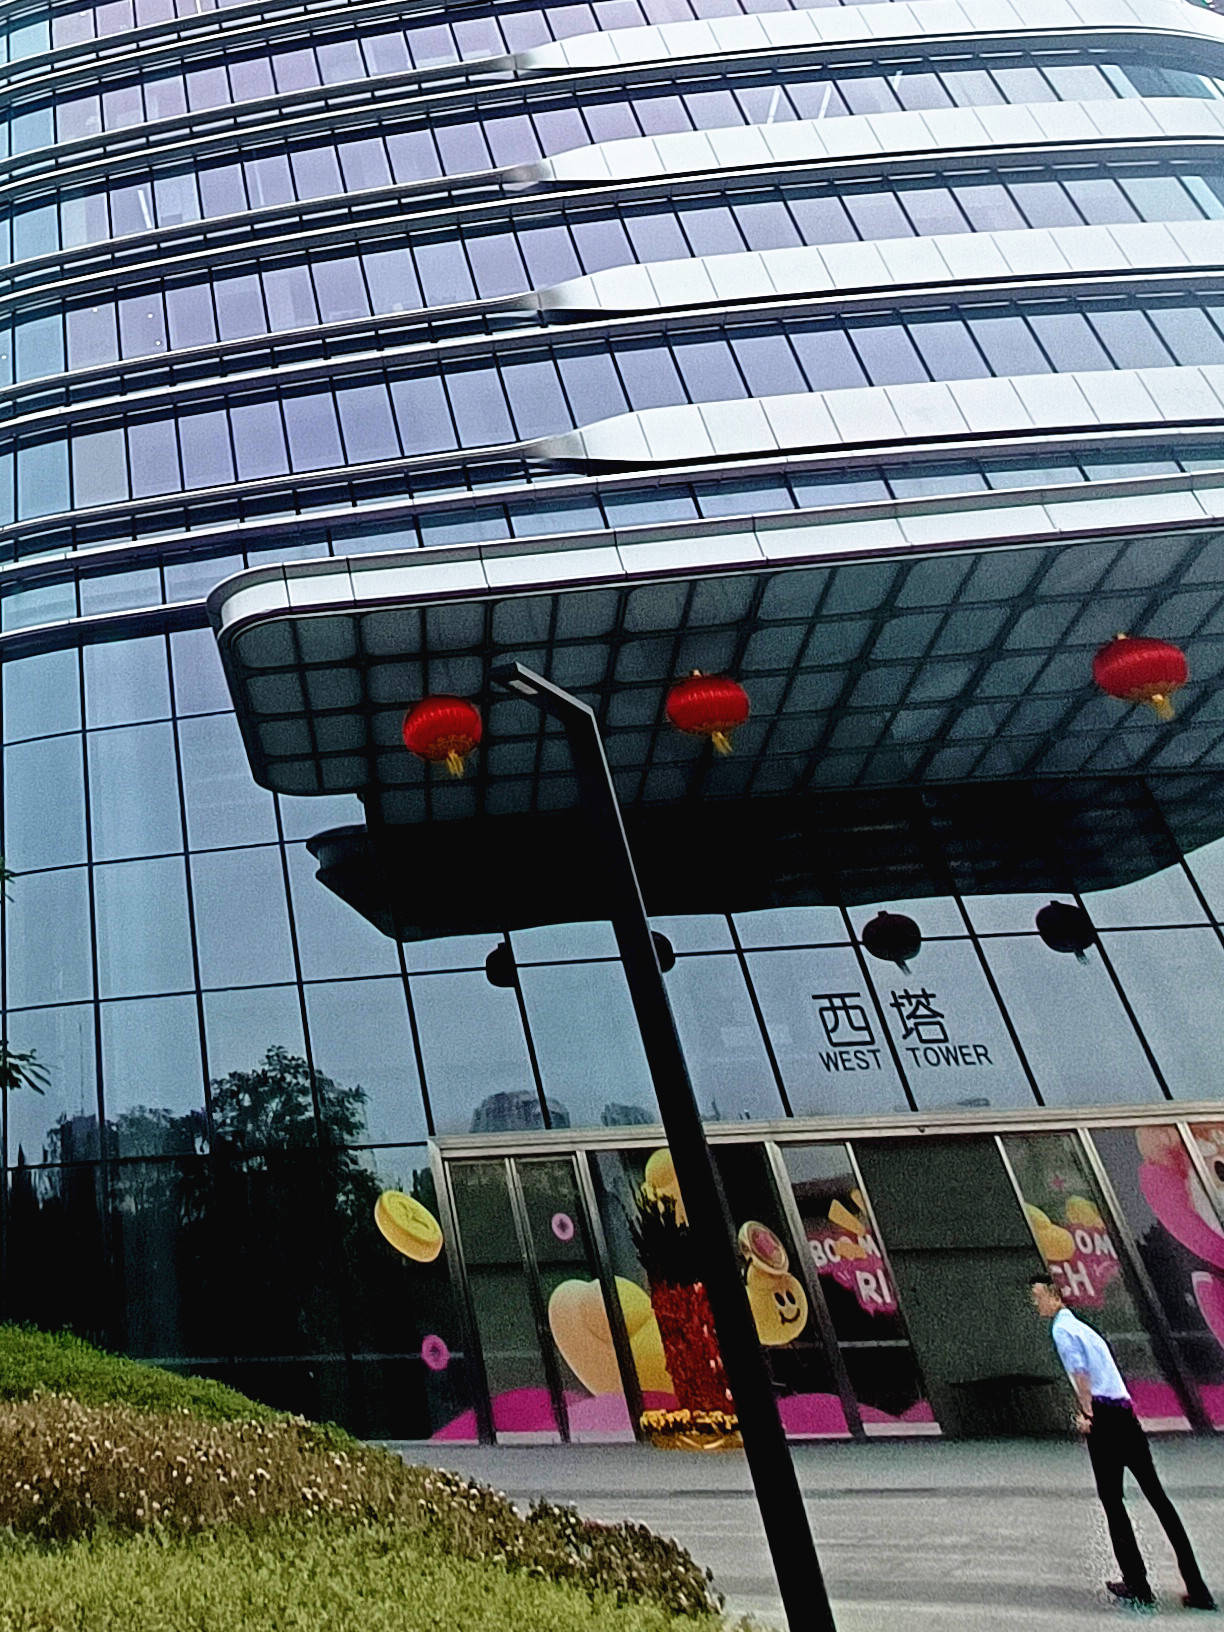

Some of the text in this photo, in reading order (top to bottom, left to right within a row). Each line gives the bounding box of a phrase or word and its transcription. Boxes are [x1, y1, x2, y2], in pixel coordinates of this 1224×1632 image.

[812, 988, 949, 1047] 西塔
[819, 1044, 993, 1072] WEST TOWER
[808, 1234, 881, 1268] BOM
